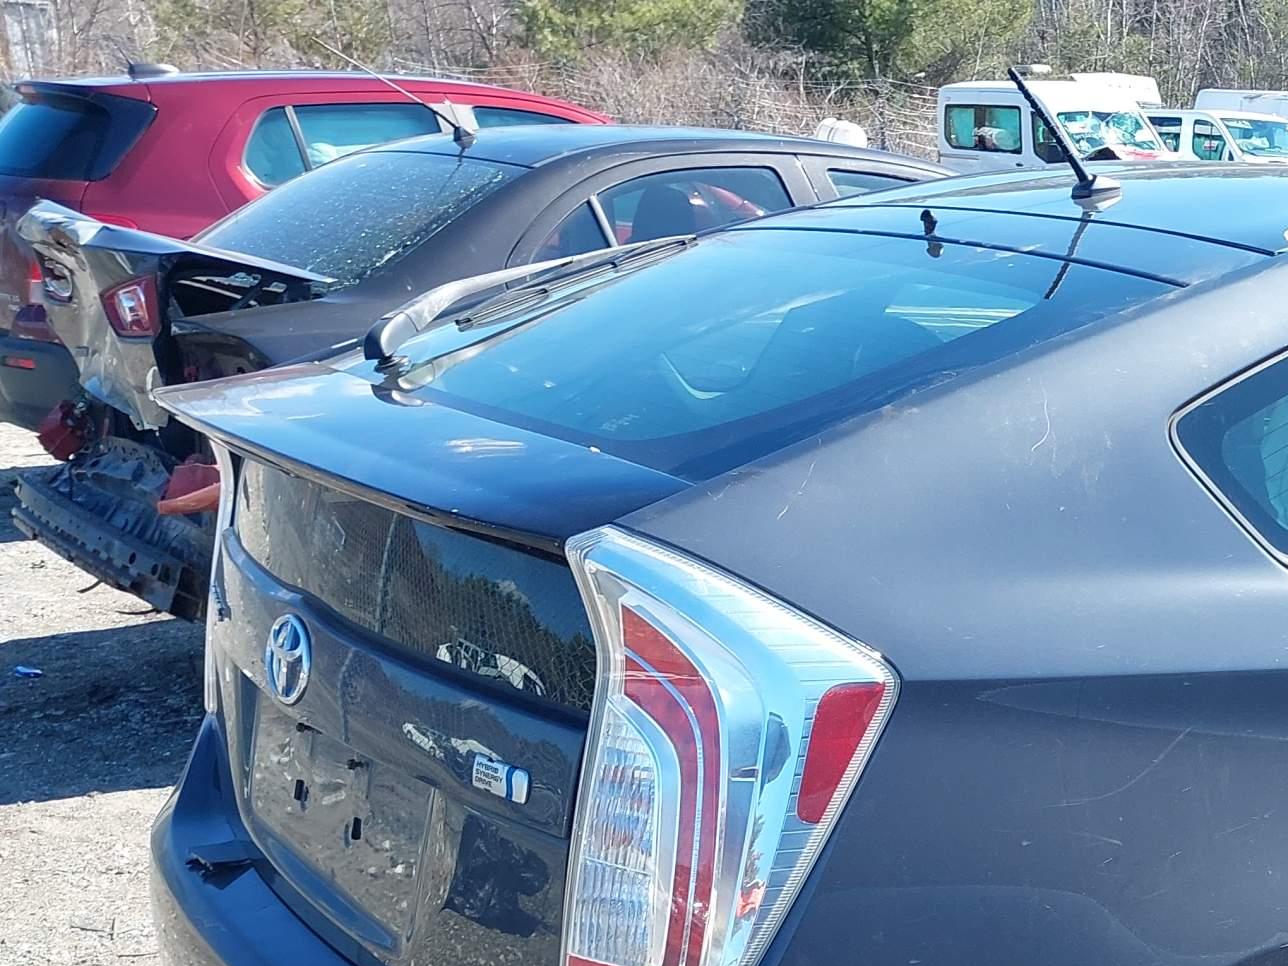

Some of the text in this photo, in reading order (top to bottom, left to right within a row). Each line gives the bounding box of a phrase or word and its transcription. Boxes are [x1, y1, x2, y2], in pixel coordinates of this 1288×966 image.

[476, 761, 500, 774] HYBRID
[474, 775, 493, 788] DRIVE
[475, 768, 504, 784] SYNERGY
